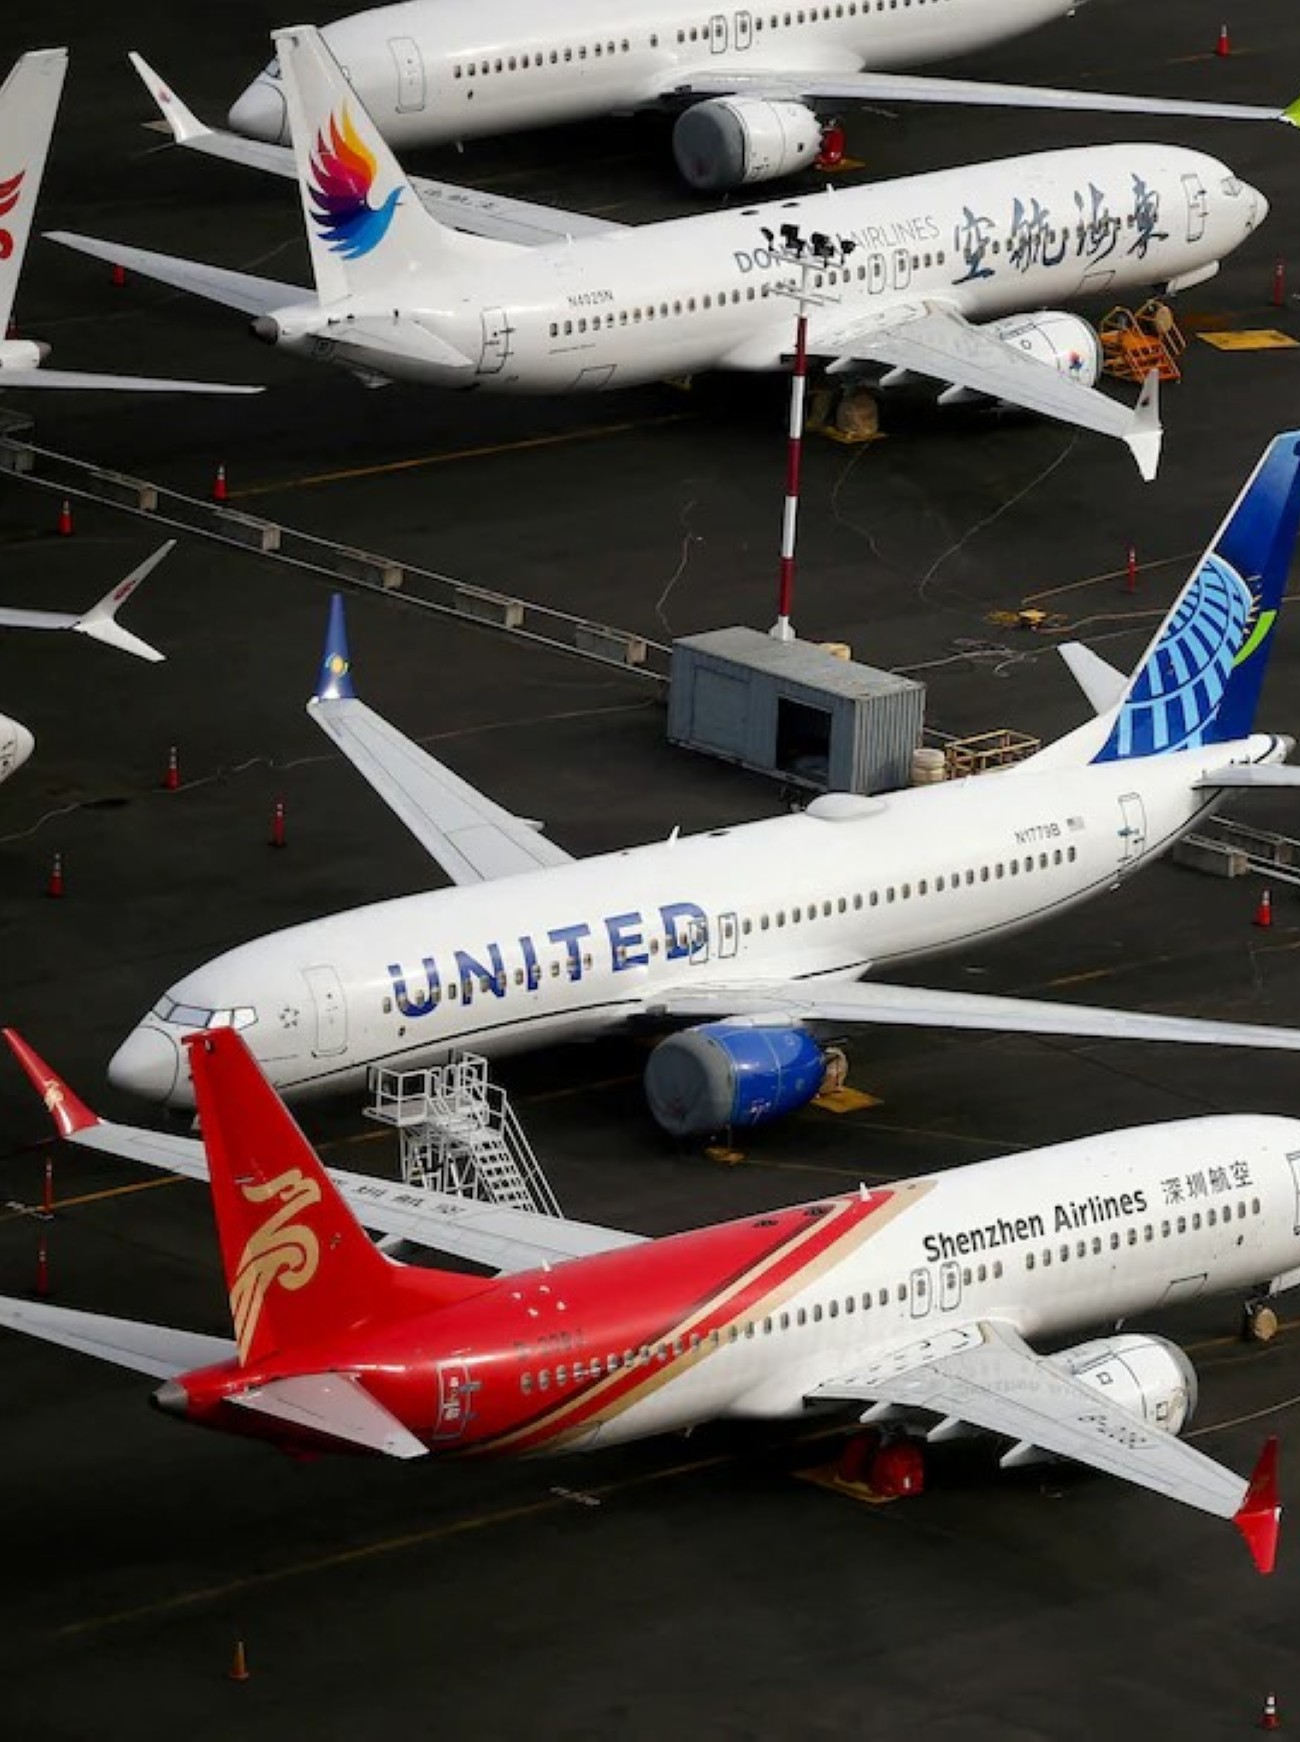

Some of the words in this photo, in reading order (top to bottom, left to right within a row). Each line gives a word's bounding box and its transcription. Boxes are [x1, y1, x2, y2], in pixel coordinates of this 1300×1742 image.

[850, 214, 941, 252] AIRLINES
[387, 901, 709, 1018] UNITED
[921, 1211, 1045, 1263] Shenzhen
[1053, 1189, 1149, 1234] Airlines
[1160, 1160, 1254, 1206] 深圳航空
